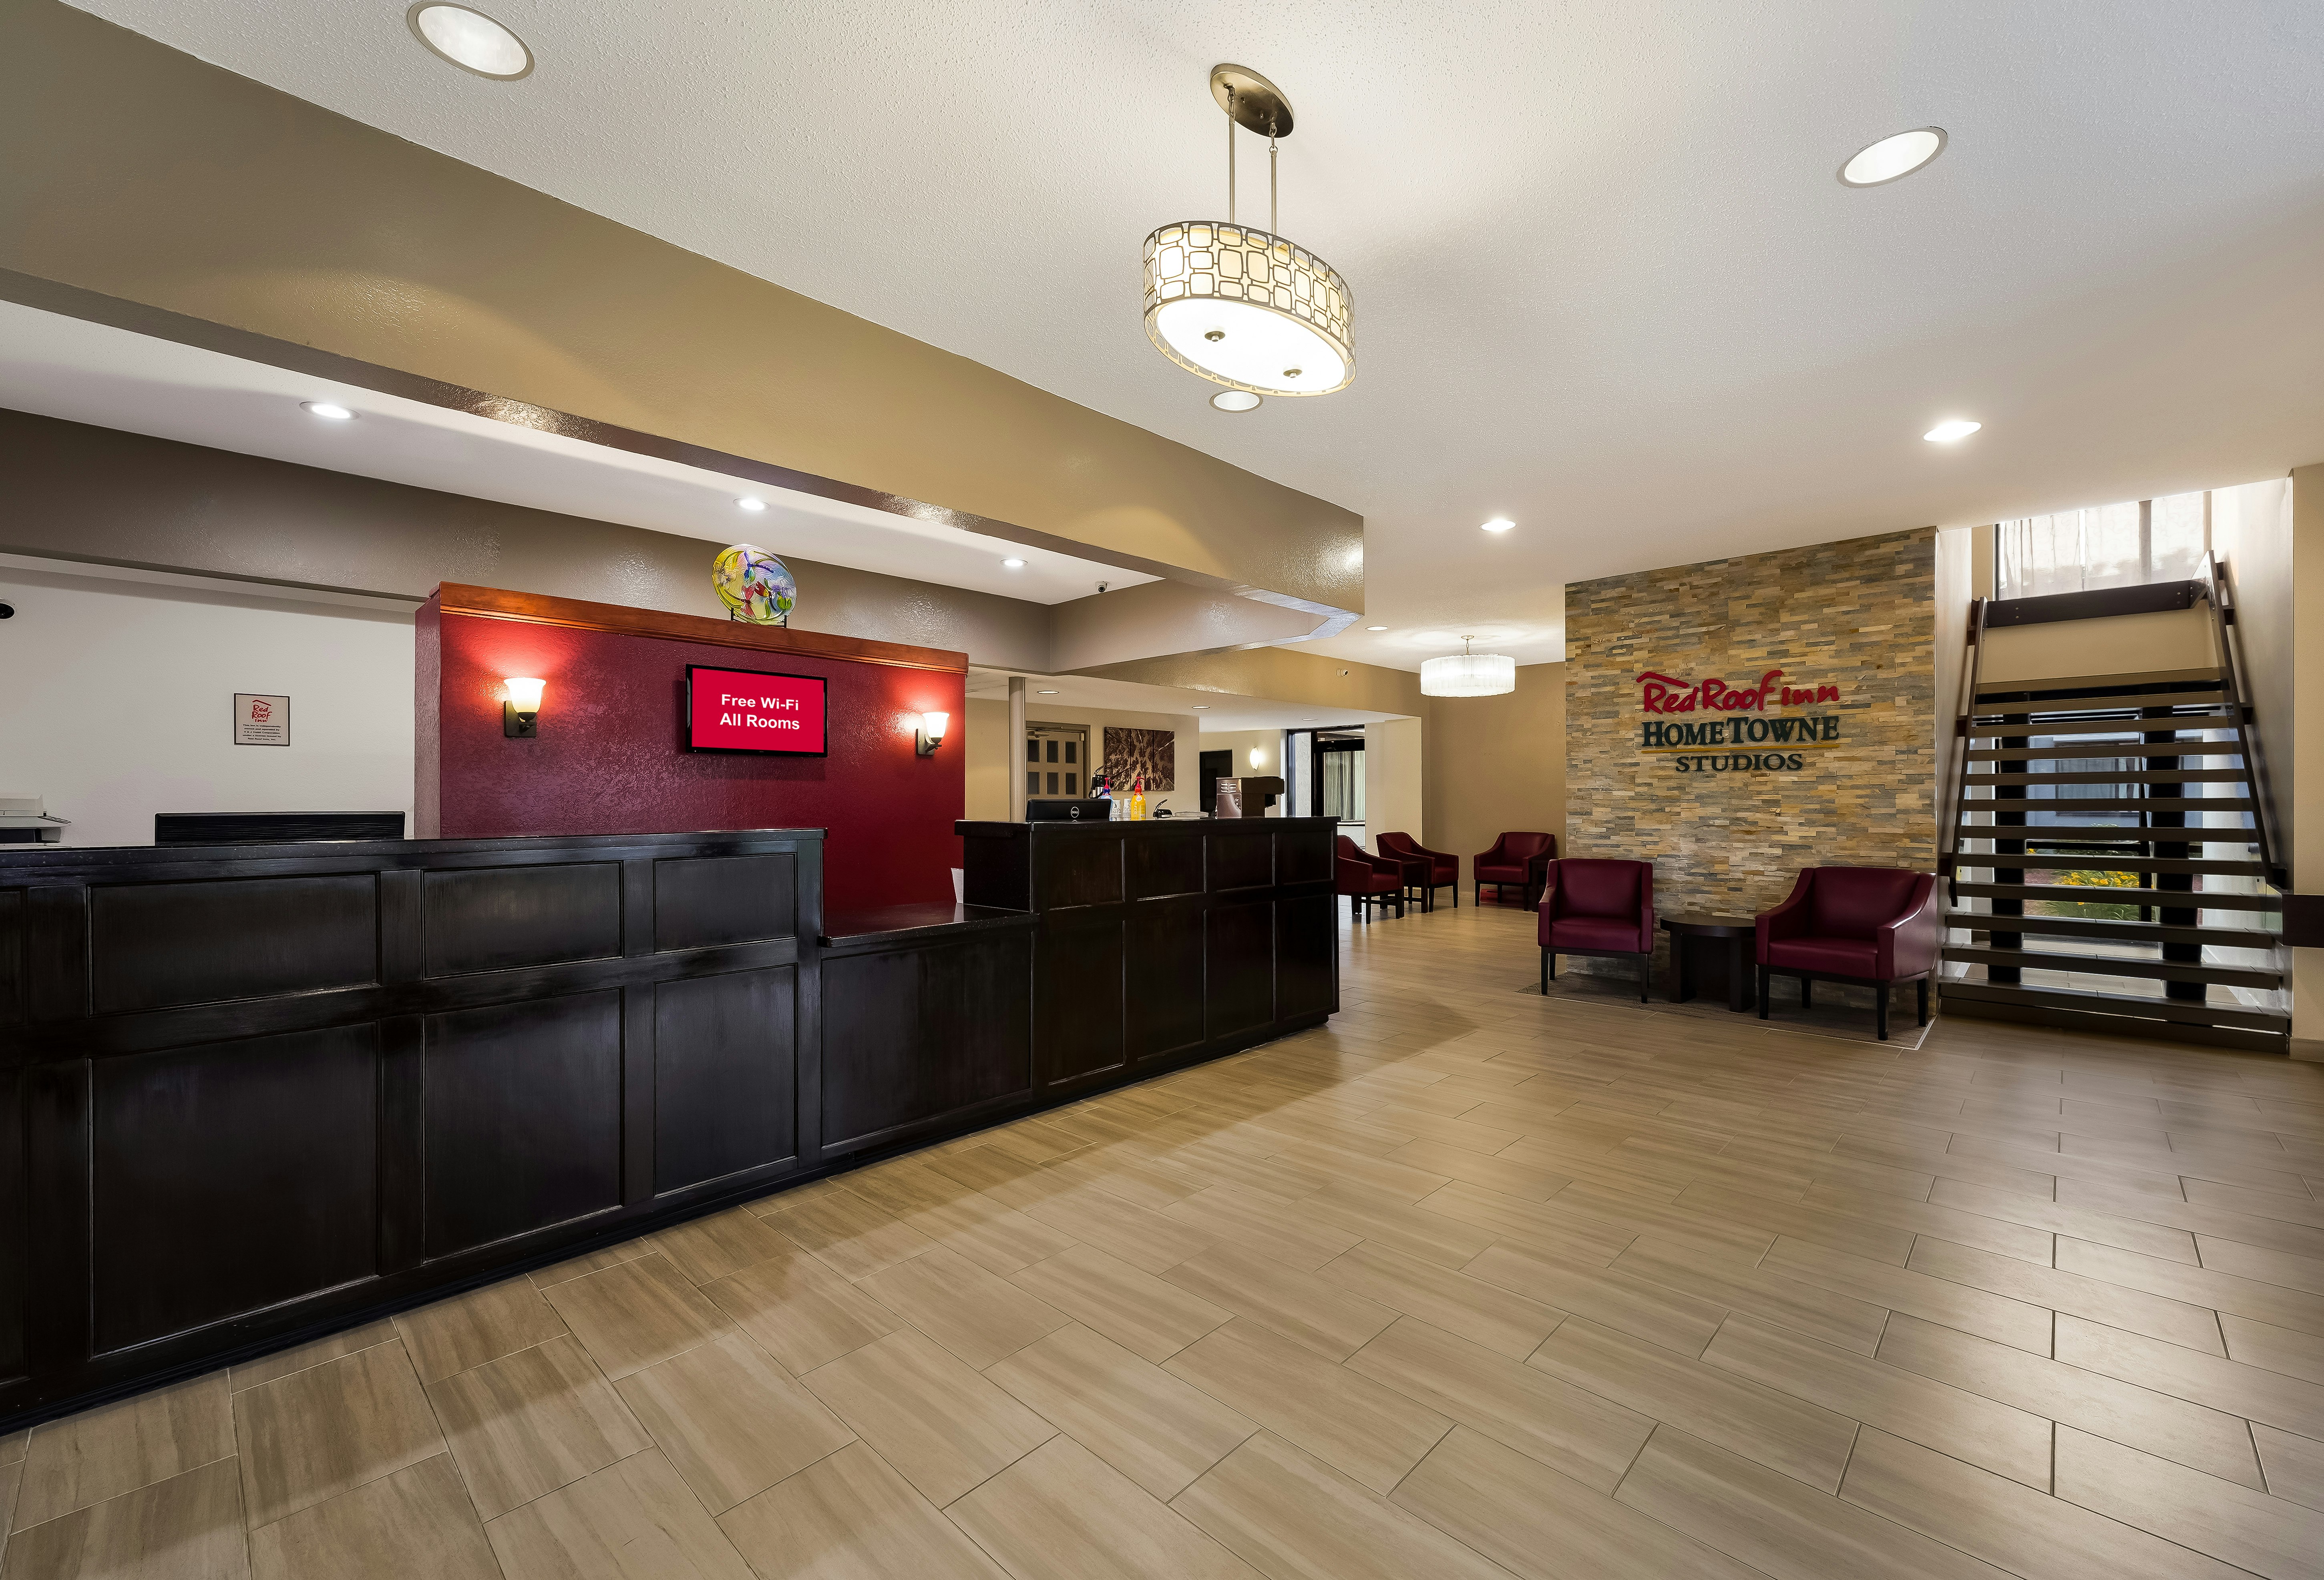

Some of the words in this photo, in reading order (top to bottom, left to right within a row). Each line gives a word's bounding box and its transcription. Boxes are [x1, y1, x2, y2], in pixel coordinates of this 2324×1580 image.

[1644, 683, 1699, 714] Red
[1702, 670, 1783, 711] Roof
[722, 694, 756, 707] Free
[760, 697, 799, 711] Wi-Fi
[251, 711, 273, 720] Roof
[720, 713, 741, 726] All
[747, 715, 800, 730] Rooms
[1642, 716, 1840, 747] HOMETOWNE
[1675, 753, 1803, 772] STUDIOS
